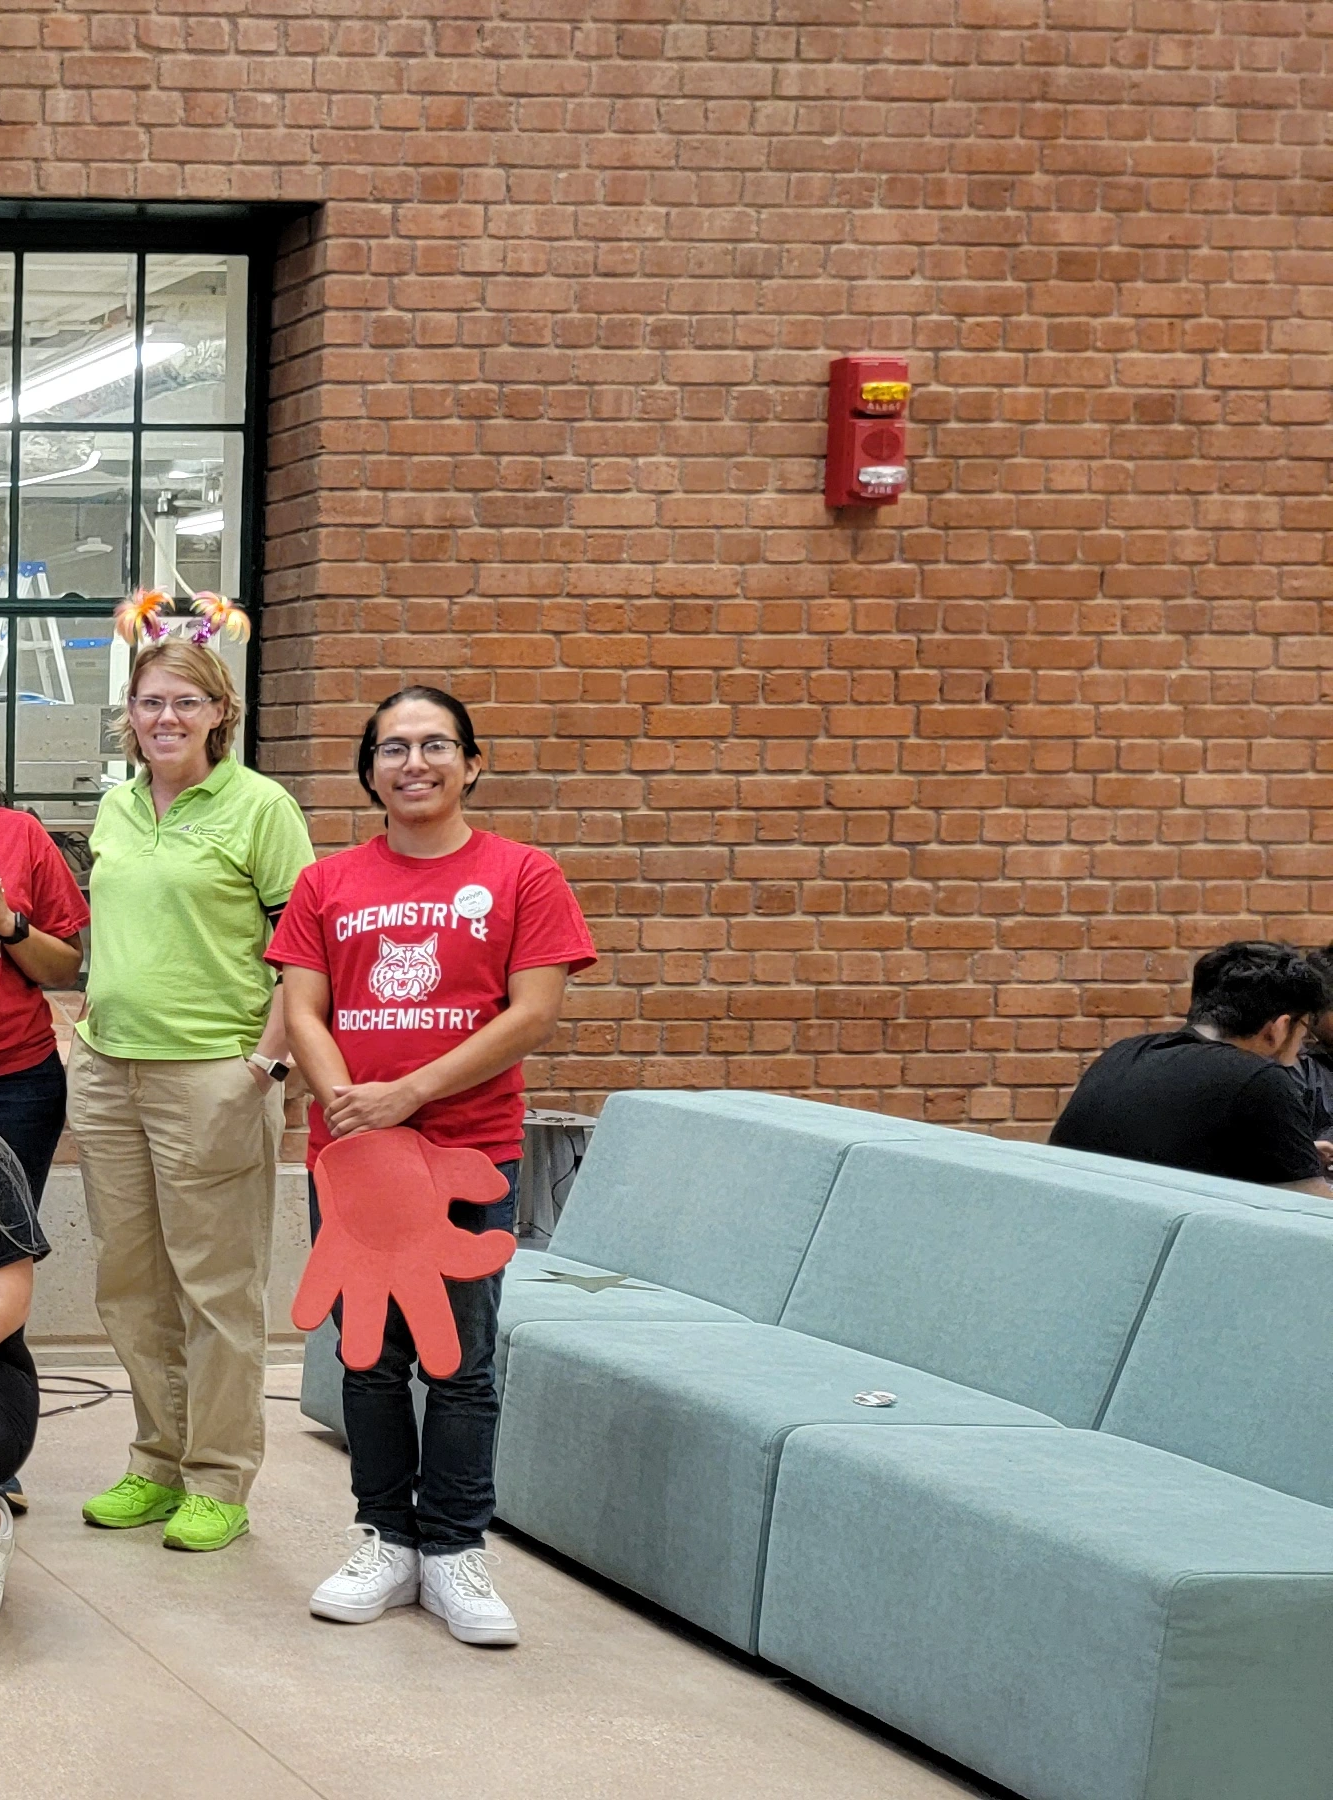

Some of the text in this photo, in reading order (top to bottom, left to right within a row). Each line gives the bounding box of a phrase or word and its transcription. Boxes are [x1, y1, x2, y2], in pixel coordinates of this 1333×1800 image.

[867, 485, 893, 494] FIRE
[336, 902, 460, 942] CHEMISTRY
[337, 1008, 481, 1031] BIOCHEMISTRY
